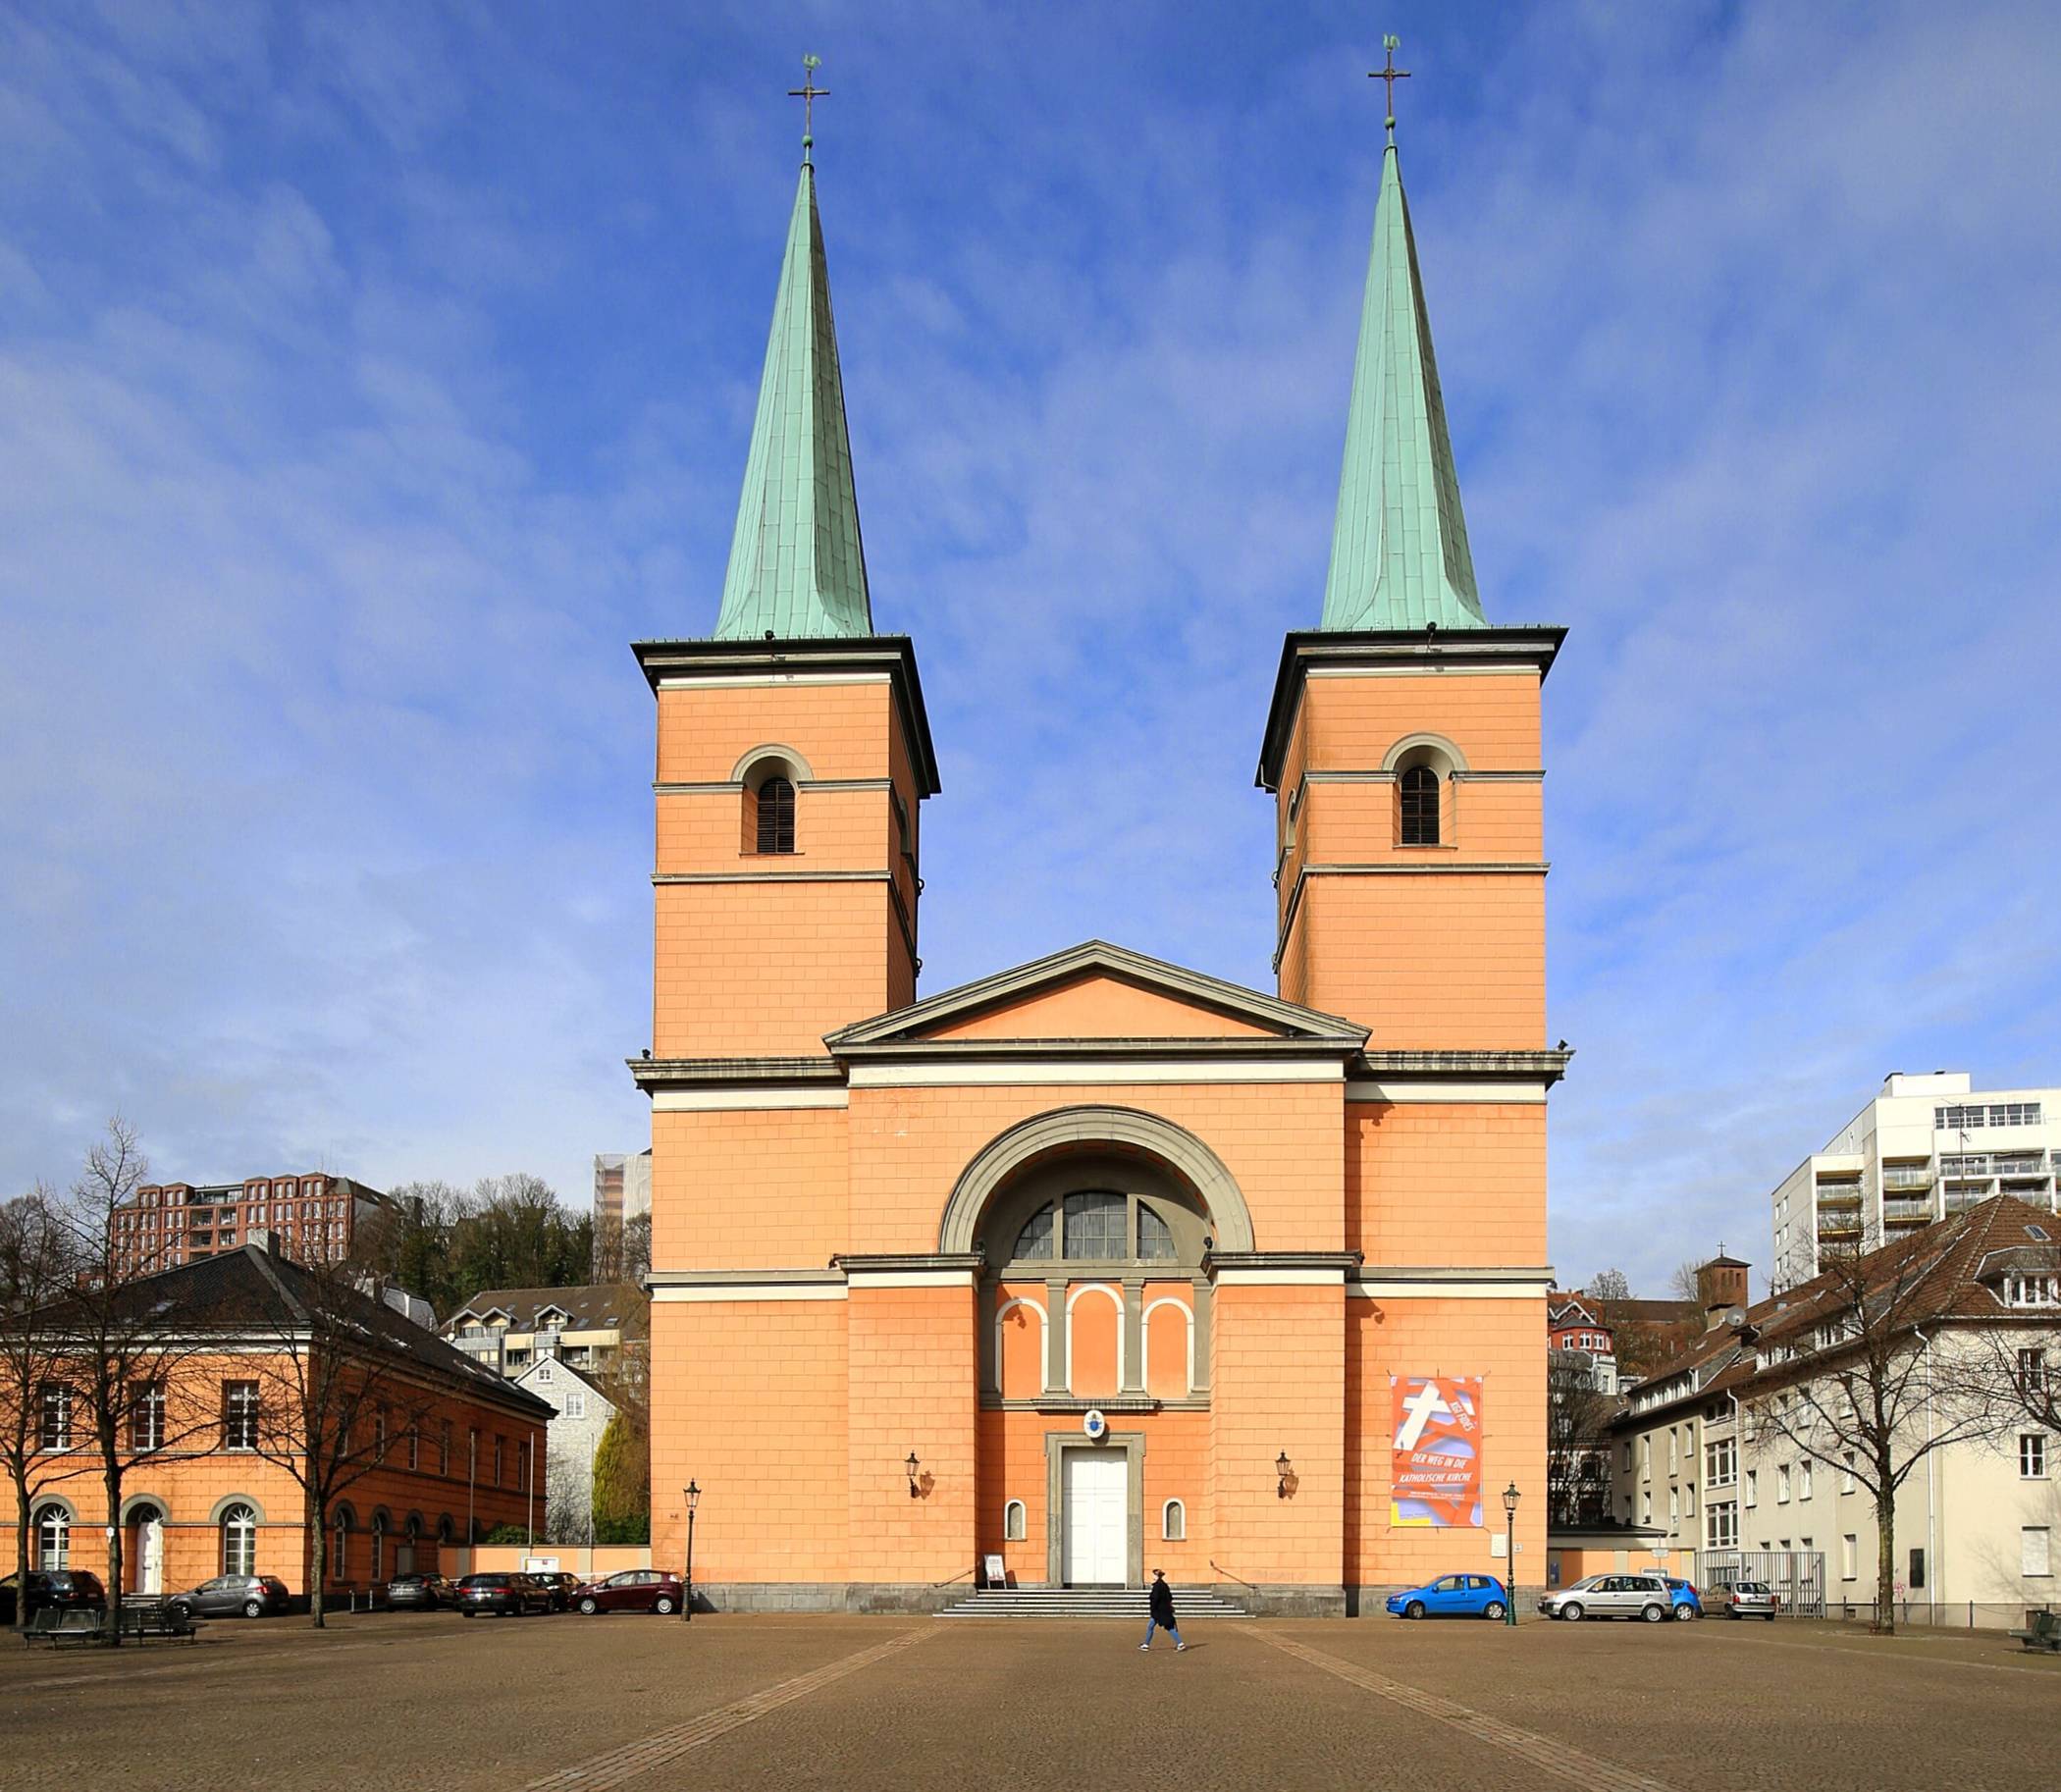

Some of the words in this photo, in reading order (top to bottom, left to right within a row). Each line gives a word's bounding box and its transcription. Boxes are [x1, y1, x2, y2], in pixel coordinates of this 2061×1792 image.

[1412, 1452, 1427, 1462] DER
[1428, 1454, 1445, 1466] WEG
[1444, 1457, 1453, 1467] IN
[1453, 1458, 1467, 1469] DIE
[1400, 1473, 1445, 1483] KATHOLISCHE
[1447, 1473, 1471, 1482] KIRCHE
